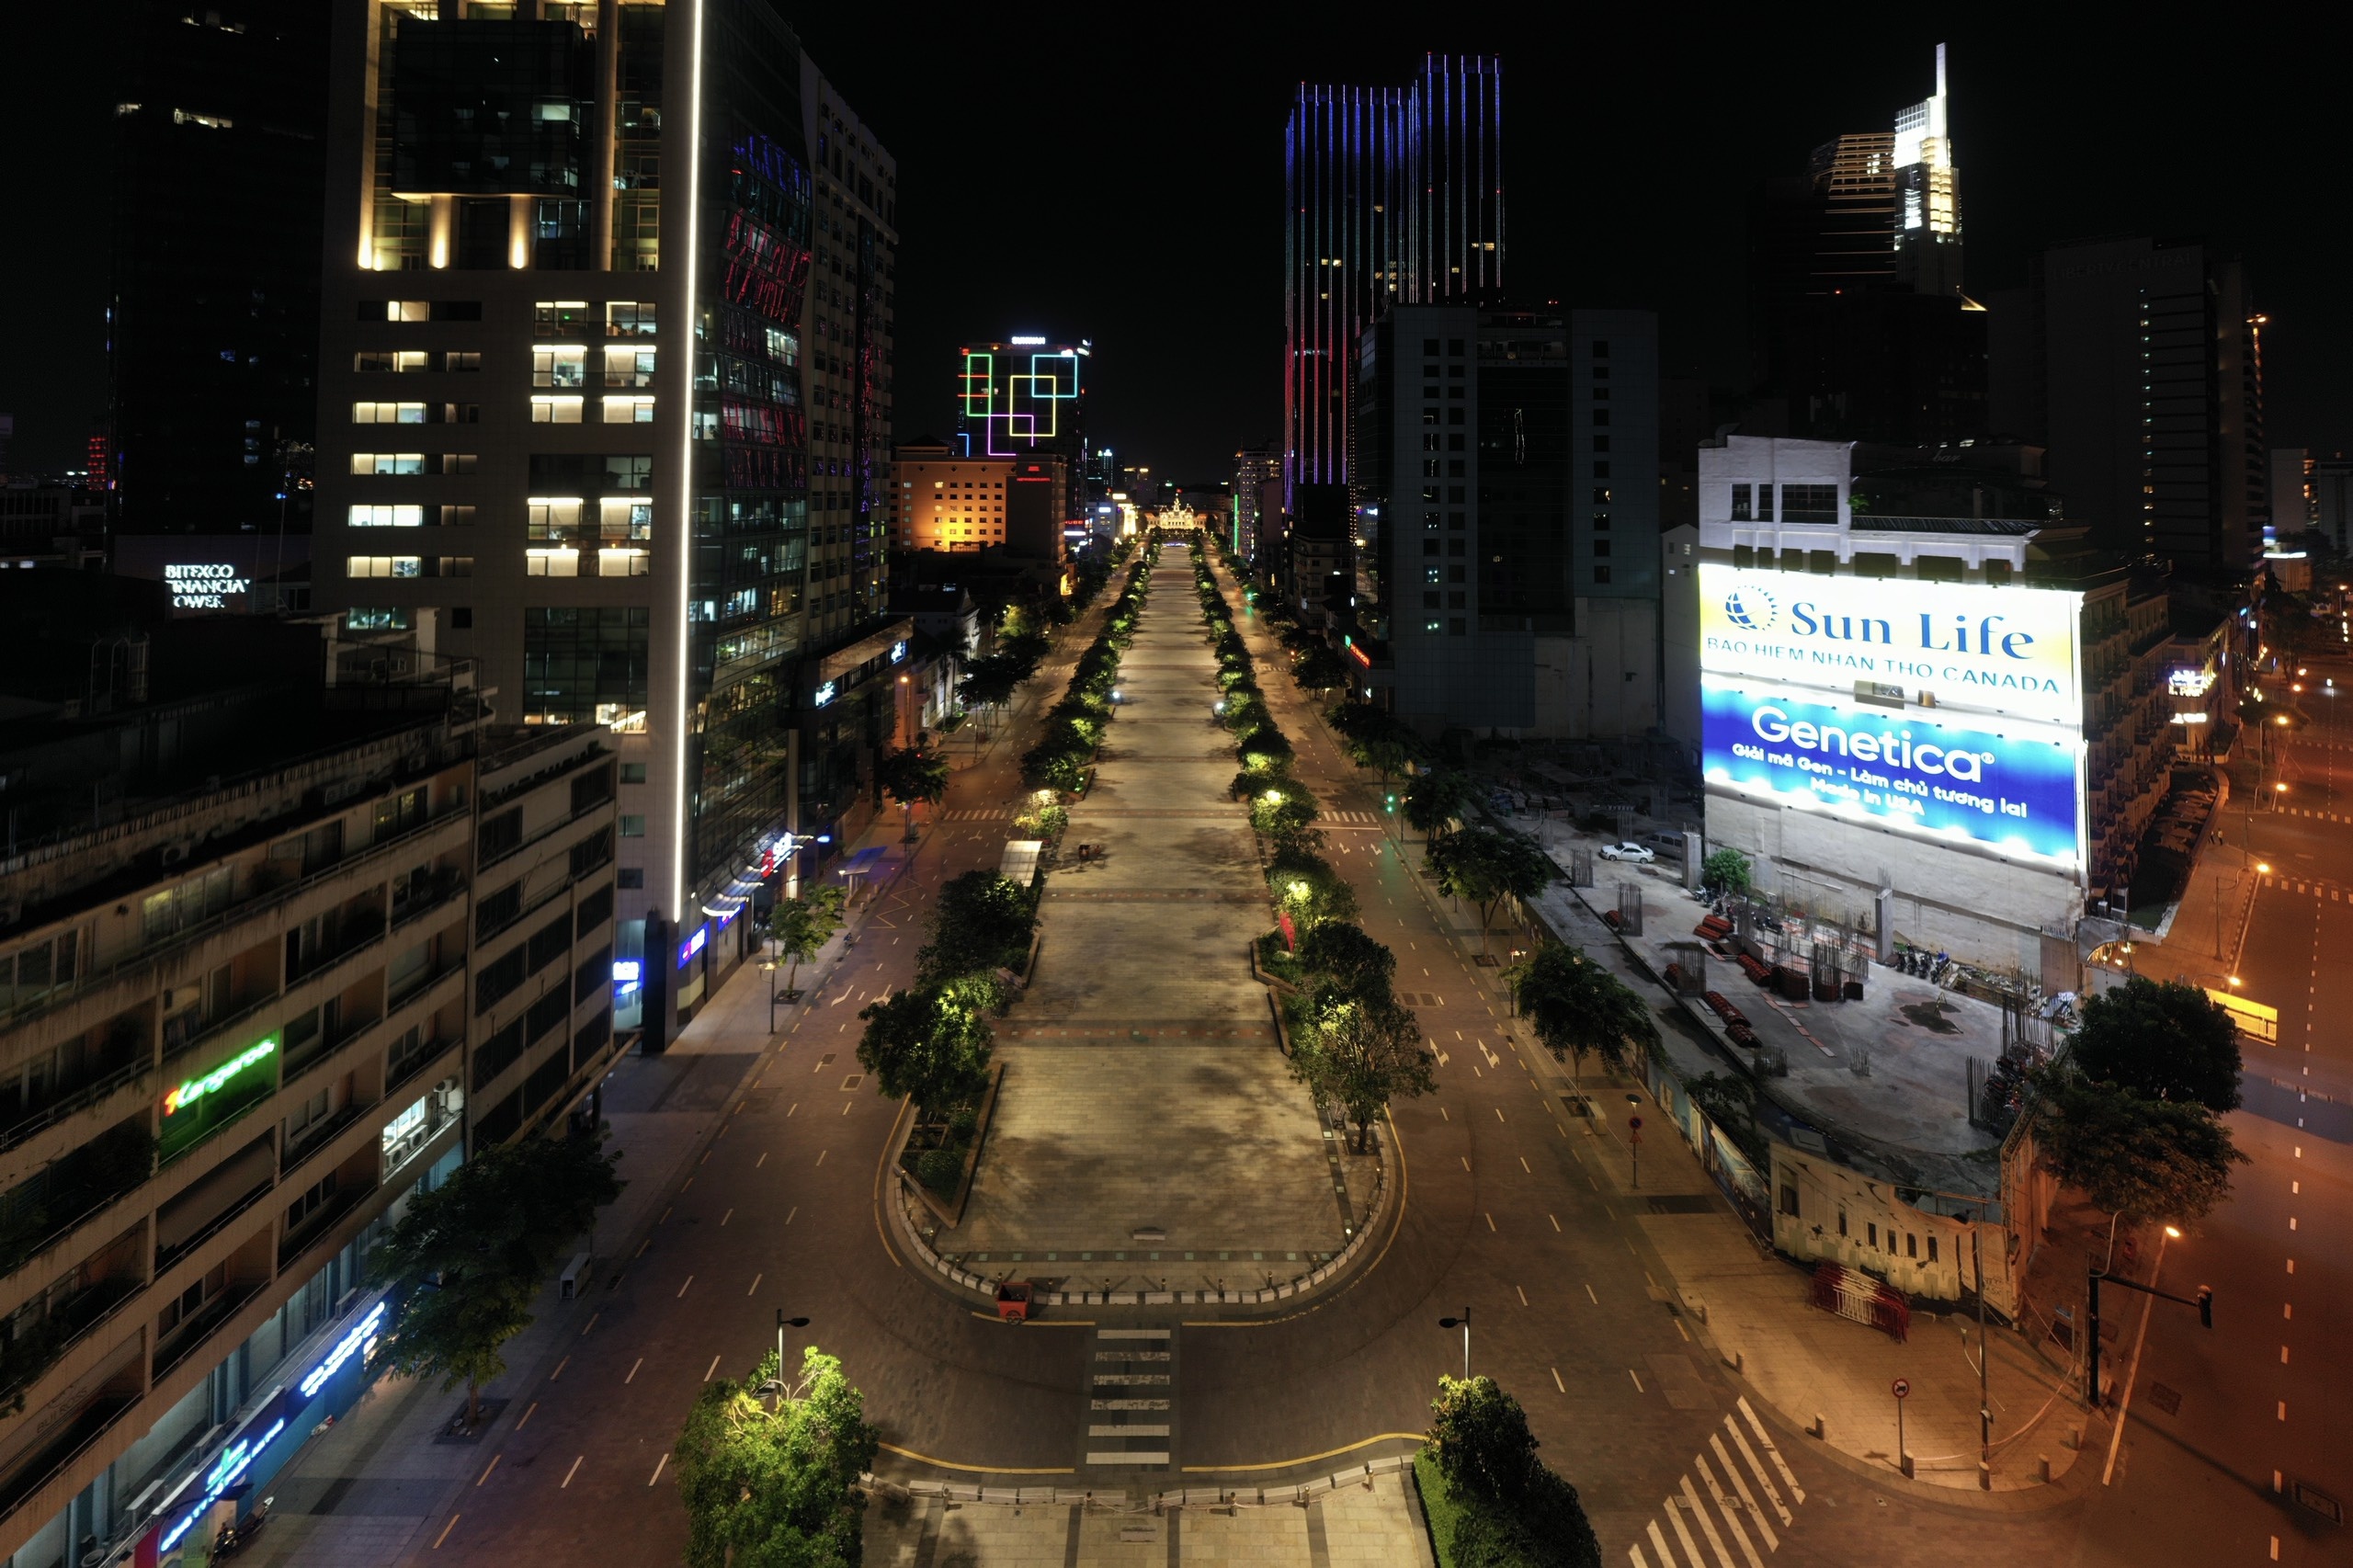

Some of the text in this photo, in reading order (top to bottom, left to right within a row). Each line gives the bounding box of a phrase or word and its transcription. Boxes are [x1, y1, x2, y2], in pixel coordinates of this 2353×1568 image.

[165, 564, 233, 578] BITEXCO
[165, 579, 250, 594] INANCIA
[1791, 602, 2034, 660] Sun Life
[1943, 666, 2060, 694] CANADA
[2000, 797, 2028, 818] lai
